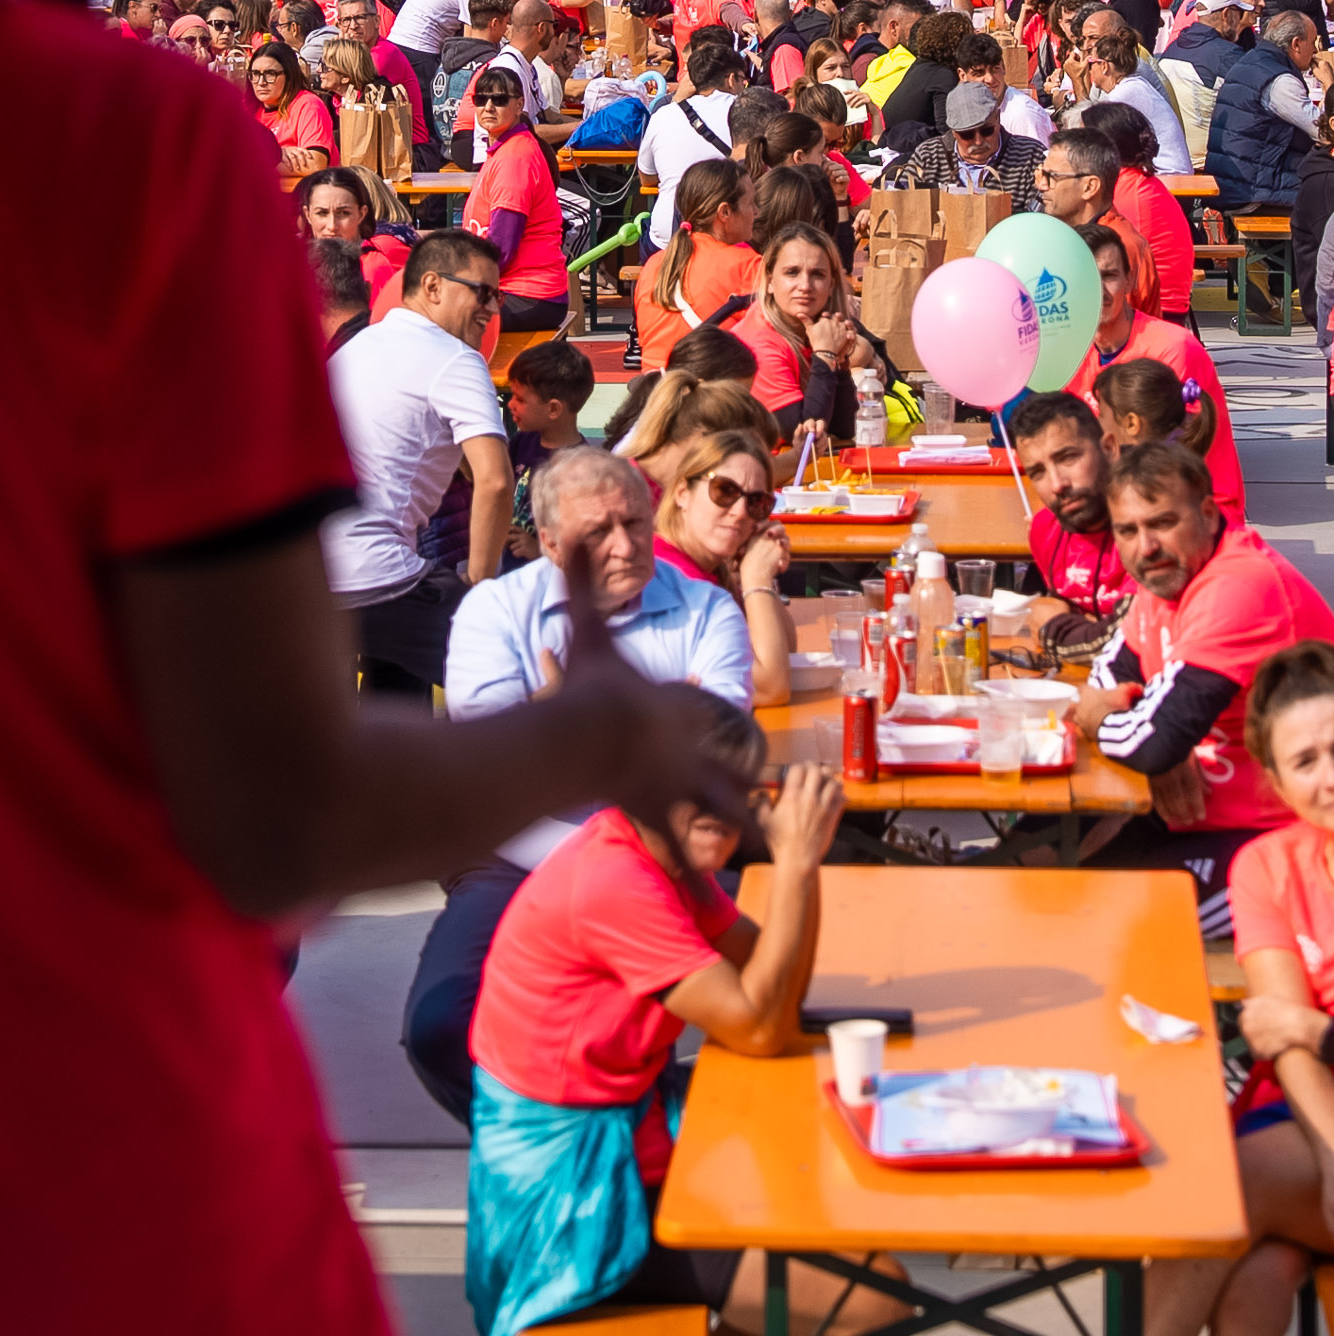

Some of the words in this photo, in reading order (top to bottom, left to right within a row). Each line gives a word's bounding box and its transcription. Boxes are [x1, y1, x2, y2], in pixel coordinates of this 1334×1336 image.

[1039, 302, 1069, 317] DAS
[1041, 315, 1070, 324] RONA
[1017, 321, 1039, 338] FIDA
